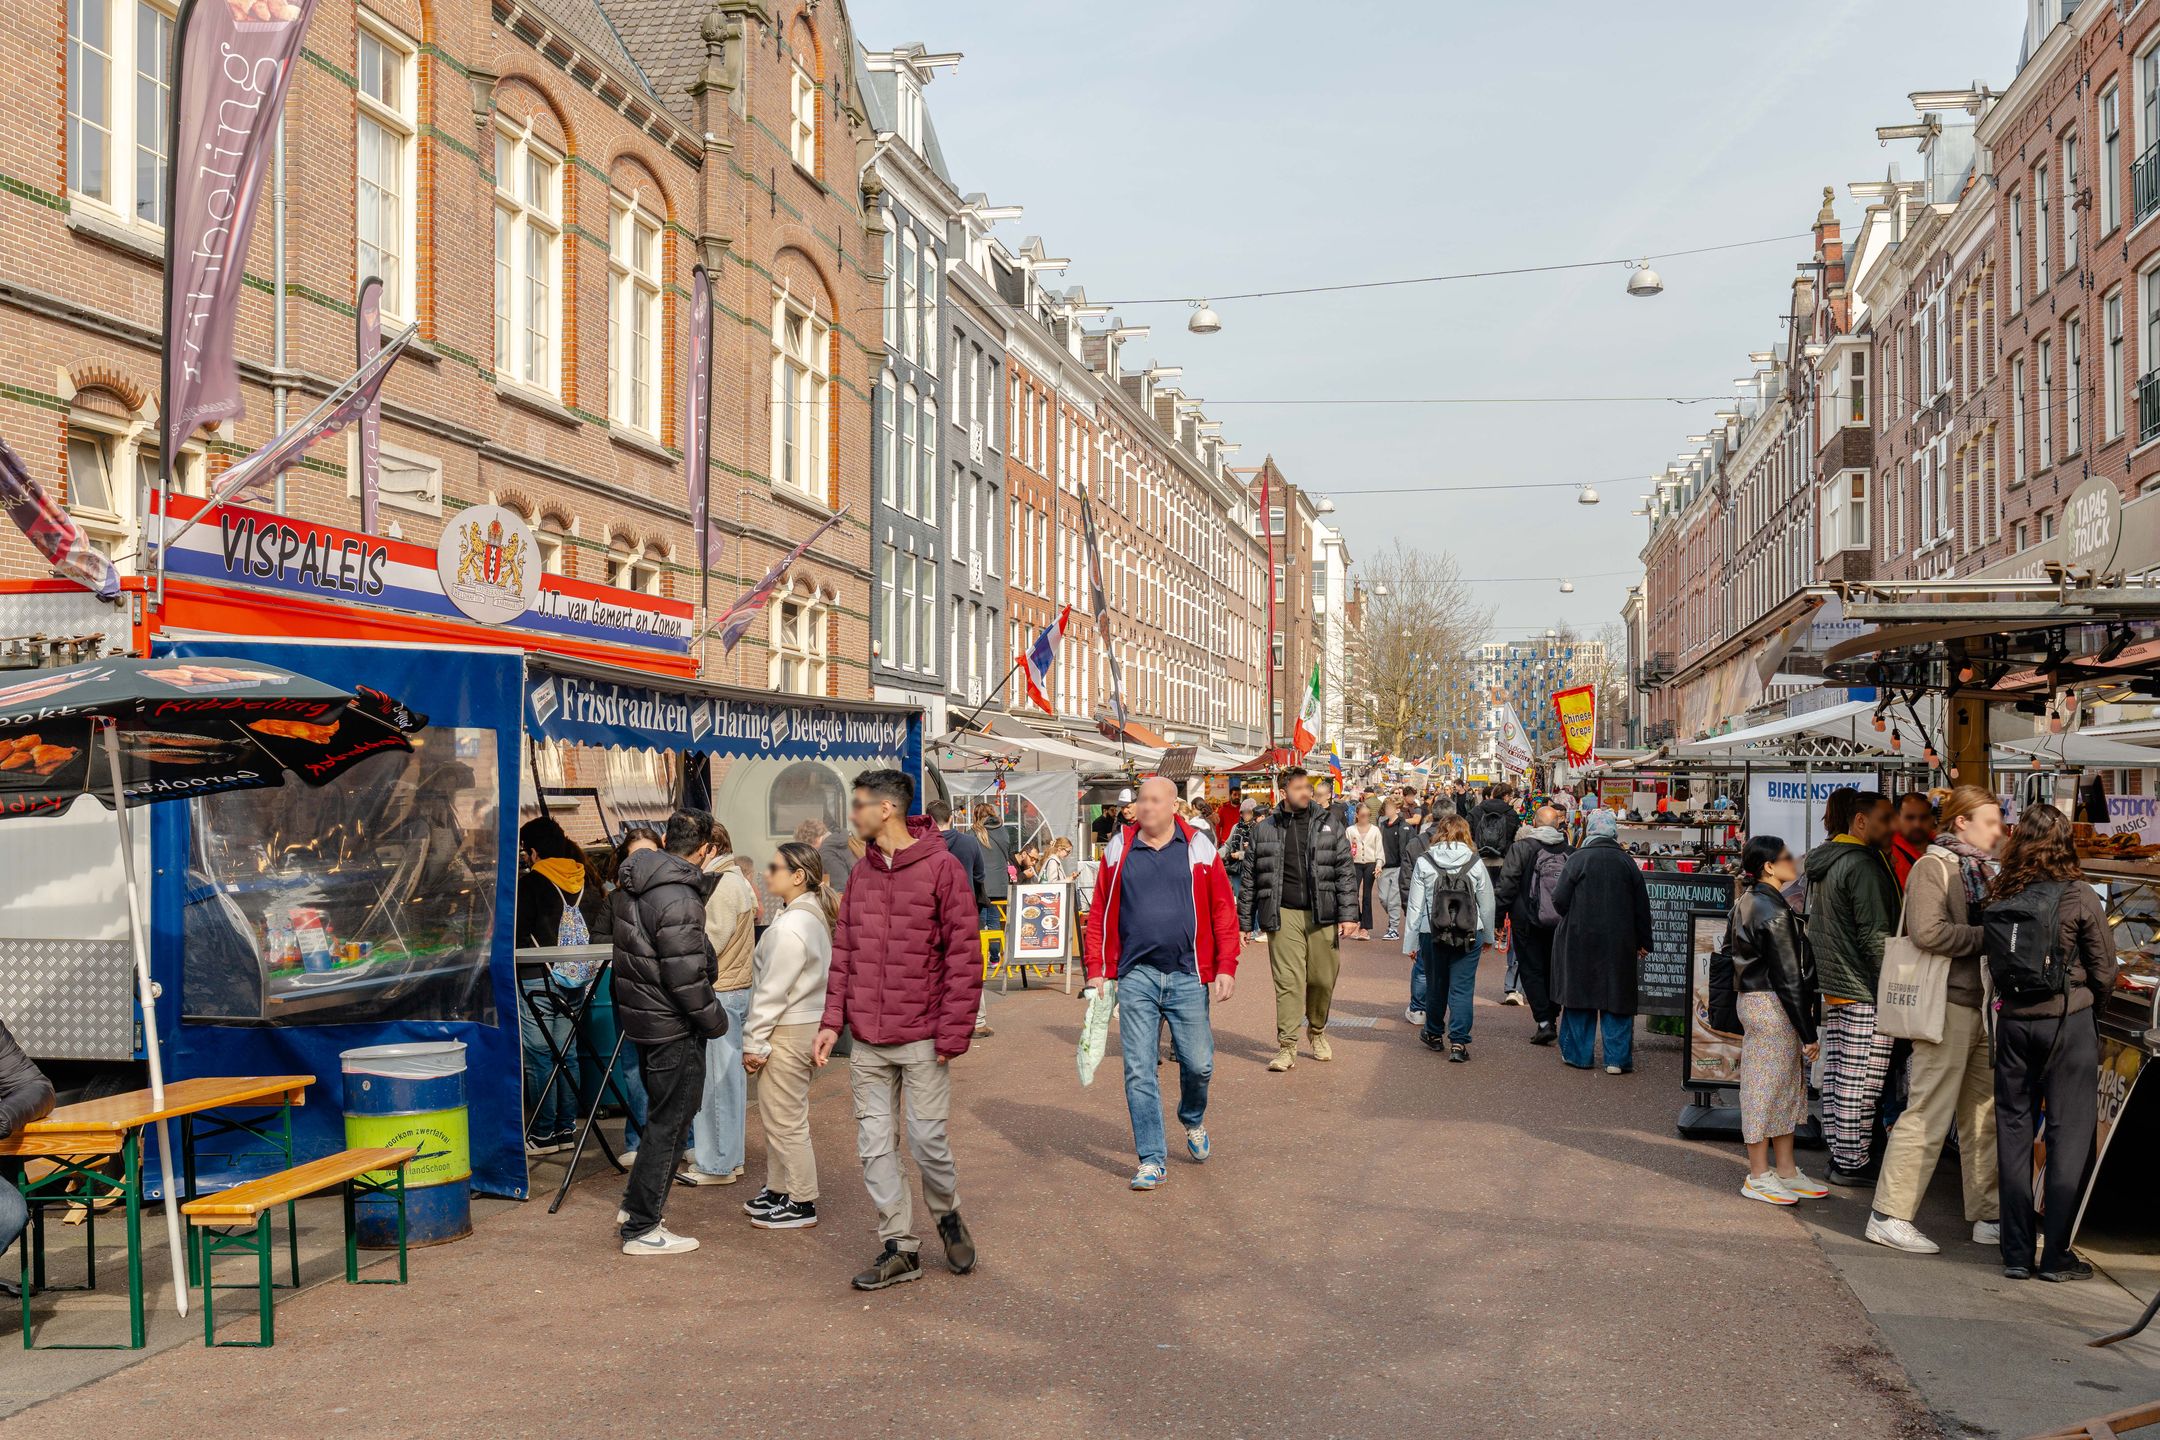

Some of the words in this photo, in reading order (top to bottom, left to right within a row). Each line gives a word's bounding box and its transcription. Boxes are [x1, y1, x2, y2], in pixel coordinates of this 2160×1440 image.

[2076, 488, 2108, 526] TAPAS
[2075, 516, 2110, 557] TRUCK
[221, 513, 388, 597] VISPALEIS
[538, 588, 563, 619] J.T.
[567, 600, 588, 623] van
[592, 597, 632, 629] Gemert
[635, 612, 648, 633] en
[651, 611, 682, 639] Zonen
[155, 696, 331, 717] Kibbeling
[561, 678, 688, 733] Frisdranken
[713, 699, 770, 749] Haring
[791, 708, 843, 751] Belegde
[845, 711, 894, 751] broodjes
[1563, 711, 1592, 724] Chinese
[1570, 725, 1592, 737] Crepe
[1768, 781, 1861, 800] BIRKENSTK
[2116, 817, 2147, 834] BASICS
[1647, 883, 1704, 901] EDITERRANEAN
[386, 1162, 451, 1177] NerlandSchoon
